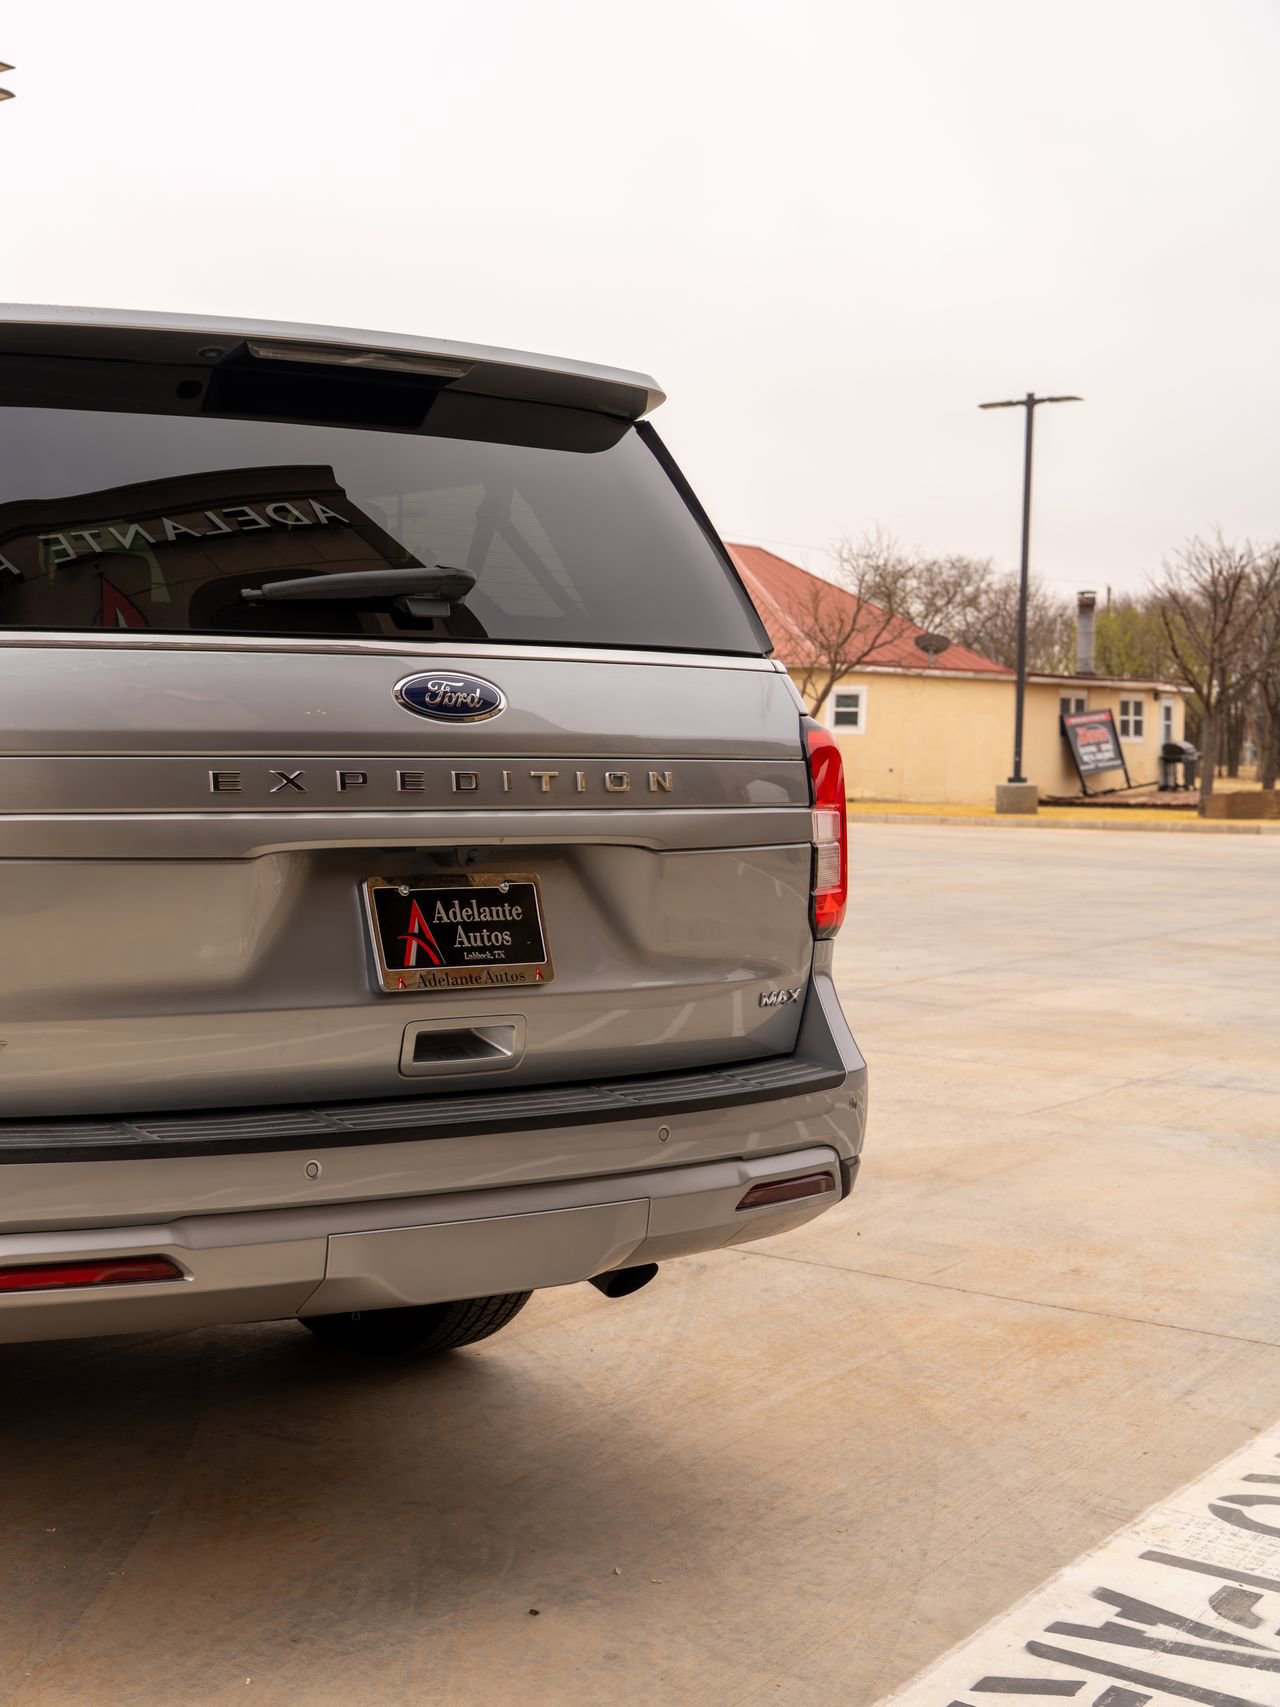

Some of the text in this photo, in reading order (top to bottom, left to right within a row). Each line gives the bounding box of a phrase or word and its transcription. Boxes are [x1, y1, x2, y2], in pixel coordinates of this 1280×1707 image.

[425, 680, 483, 708] Ford
[208, 770, 674, 793] EXPEDITION
[432, 900, 523, 924] Adelante
[453, 925, 512, 948] Autos
[417, 970, 526, 988] Adelante Autos
[759, 988, 801, 1007] MAX
